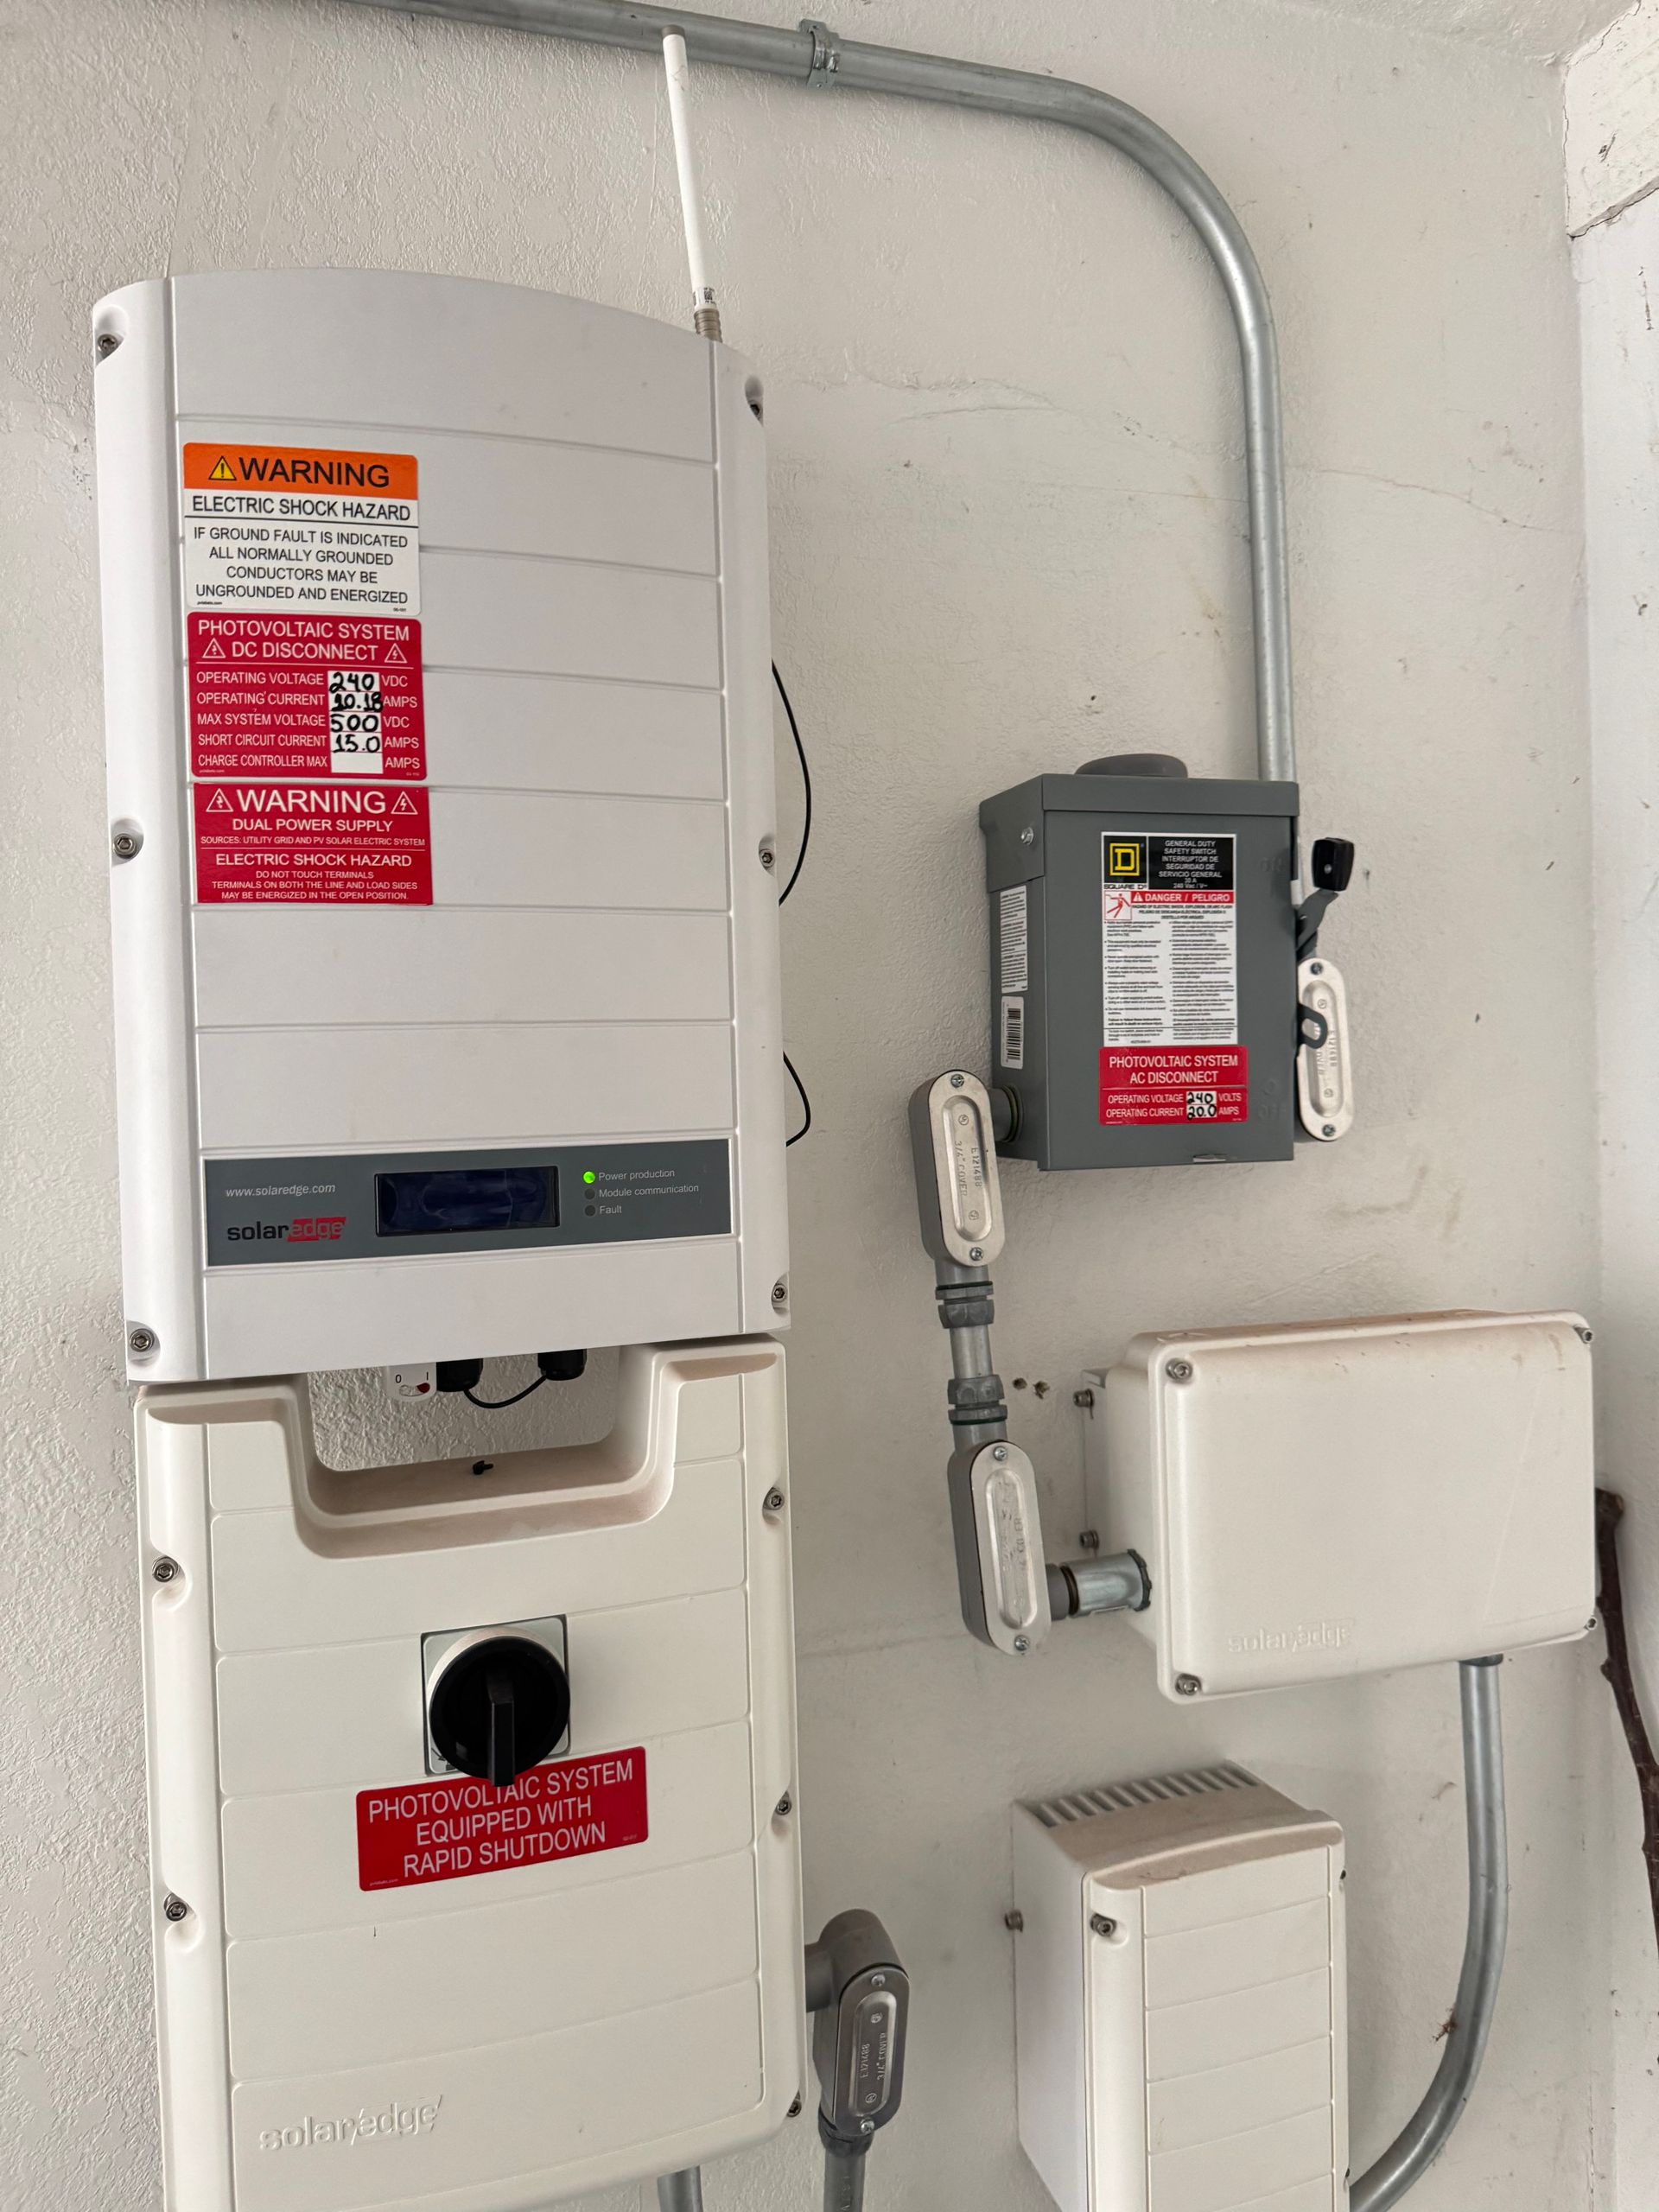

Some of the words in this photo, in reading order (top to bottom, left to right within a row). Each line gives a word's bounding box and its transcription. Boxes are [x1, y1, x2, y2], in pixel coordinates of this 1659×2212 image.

[238, 457, 390, 488] WARNING
[193, 495, 274, 514] ELECTRIC
[279, 499, 338, 517] SHOCK
[343, 501, 410, 521] HAZARD
[194, 527, 206, 539] IF
[210, 527, 270, 542] GROUND
[274, 530, 316, 543] FAULT
[321, 531, 333, 543] IS
[337, 532, 408, 547] INDICATED
[209, 547, 233, 559] ALL
[238, 548, 311, 562] NORMALLY
[315, 550, 393, 565] GROUNDED
[226, 566, 324, 582] CONDUCTORS
[327, 569, 357, 582] MAY
[360, 571, 378, 583] BE
[196, 584, 294, 599] UNGROUNDED
[298, 588, 327, 600] AND
[331, 588, 408, 604] ENERGIZED
[198, 620, 334, 638] PHOTOVOLTAIC
[339, 623, 409, 641] SYSTEM
[232, 641, 257, 658] DC
[263, 642, 378, 660] DISCONNECT
[196, 671, 266, 684] OPERATING
[269, 672, 324, 685] VOLTAGE
[329, 671, 374, 694] 240
[382, 675, 408, 687] VDC
[197, 692, 264, 705] OPERATING
[268, 693, 325, 706] CURRENT
[383, 696, 417, 708] AMPS
[197, 714, 221, 726] MAX
[225, 714, 271, 726] SYSTEM
[274, 714, 326, 727] VOLTAGE
[330, 714, 378, 733] 500
[383, 716, 410, 728] VDC
[198, 734, 232, 746] SHORT
[235, 734, 277, 747] CIRCUIT
[279, 734, 327, 747] CURRENT
[332, 734, 380, 753] 15.0
[385, 737, 419, 748] AMPS
[198, 754, 238, 766] CHARGE
[241, 755, 307, 767] CONTROLLER
[308, 756, 327, 767] MAX
[385, 757, 420, 769] AMPS
[237, 789, 386, 814] WARNING
[232, 818, 272, 831] DUAL
[276, 819, 333, 832] POWER
[336, 820, 393, 832] SUPPLY
[200, 836, 241, 844] SOURCES:
[326, 836, 353, 845] SOLAR
[354, 837, 392, 846] ELECTRIC
[216, 854, 289, 866] ELECTRIC
[294, 854, 346, 866] SHOCK
[350, 855, 412, 867] HAZARD
[256, 870, 270, 879] DO
[271, 870, 289, 879] NOT
[291, 870, 322, 879] TOUCH
[325, 871, 374, 880] TERMINALS
[212, 880, 262, 889] TERMINALS
[264, 880, 277, 889] ON
[279, 880, 304, 889] BOTH
[346, 881, 365, 890] AND
[366, 881, 390, 890] LOAD
[221, 891, 240, 899] MAY
[242, 891, 254, 899] BE
[256, 891, 307, 899] ENERGIZED
[308, 891, 318, 899] IN
[1192, 893, 1230, 902] PELIGRO
[1109, 1055, 1192, 1068] PHOTOVOLTAIC
[1194, 1055, 1238, 1066] SYSTEM
[1129, 1072, 1146, 1084] AC
[1147, 1071, 1219, 1084] DISCONNECT
[1108, 1094, 1150, 1104] OPERATING
[1152, 1094, 1184, 1103] VOLTAGE
[1186, 1091, 1214, 1104] 240
[1218, 1093, 1242, 1102] VOLTS
[1106, 1109, 1148, 1118] OPERATING
[1150, 1108, 1185, 1116] CURRENT
[1218, 1107, 1239, 1116] AMPS
[599, 1171, 626, 1181] Power
[629, 1169, 675, 1181] production
[957, 1165, 968, 1197] COVER
[225, 1183, 336, 1198] www.solaredge.com
[599, 1188, 632, 1198] Module
[634, 1184, 699, 1196] communication
[600, 1205, 622, 1215] Fault
[227, 1218, 345, 1241] solaredge
[547, 1758, 632, 1795] SYSTEM
[416, 1807, 531, 1847] EQUIPPED
[537, 1795, 592, 1825] WITH
[404, 1846, 472, 1878] RAPID
[479, 1821, 606, 1866] SHUTDOWN
[259, 2101, 439, 2151] solaredge
